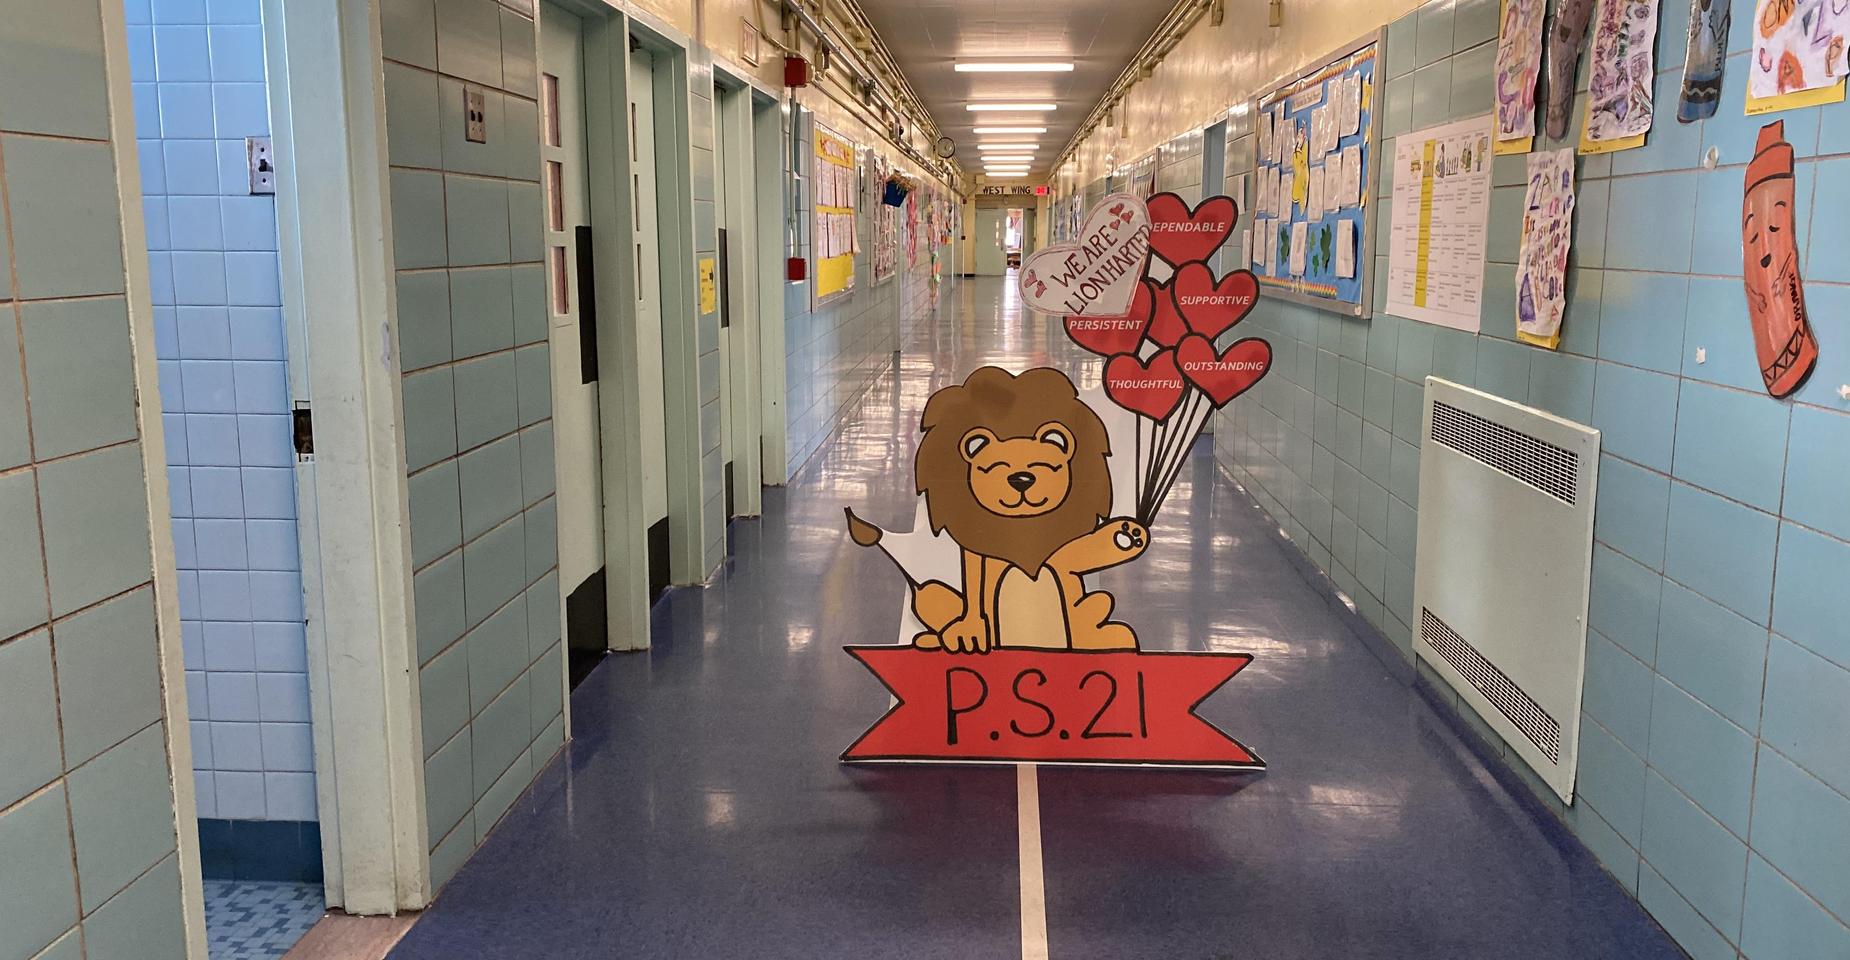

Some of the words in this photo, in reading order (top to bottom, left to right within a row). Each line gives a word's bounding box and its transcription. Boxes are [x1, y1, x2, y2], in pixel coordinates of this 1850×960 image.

[983, 186, 1005, 195] WEST
[1011, 186, 1031, 195] WING
[1152, 222, 1225, 233] EPENDABLE
[1050, 252, 1087, 288] WE
[1082, 224, 1118, 266] ARE
[1181, 295, 1250, 305] SUPPORTIVE
[1069, 320, 1143, 331] PERSISTENT
[1184, 361, 1264, 371] OUTSTANDING
[1110, 380, 1183, 389] THOUGHTFUL
